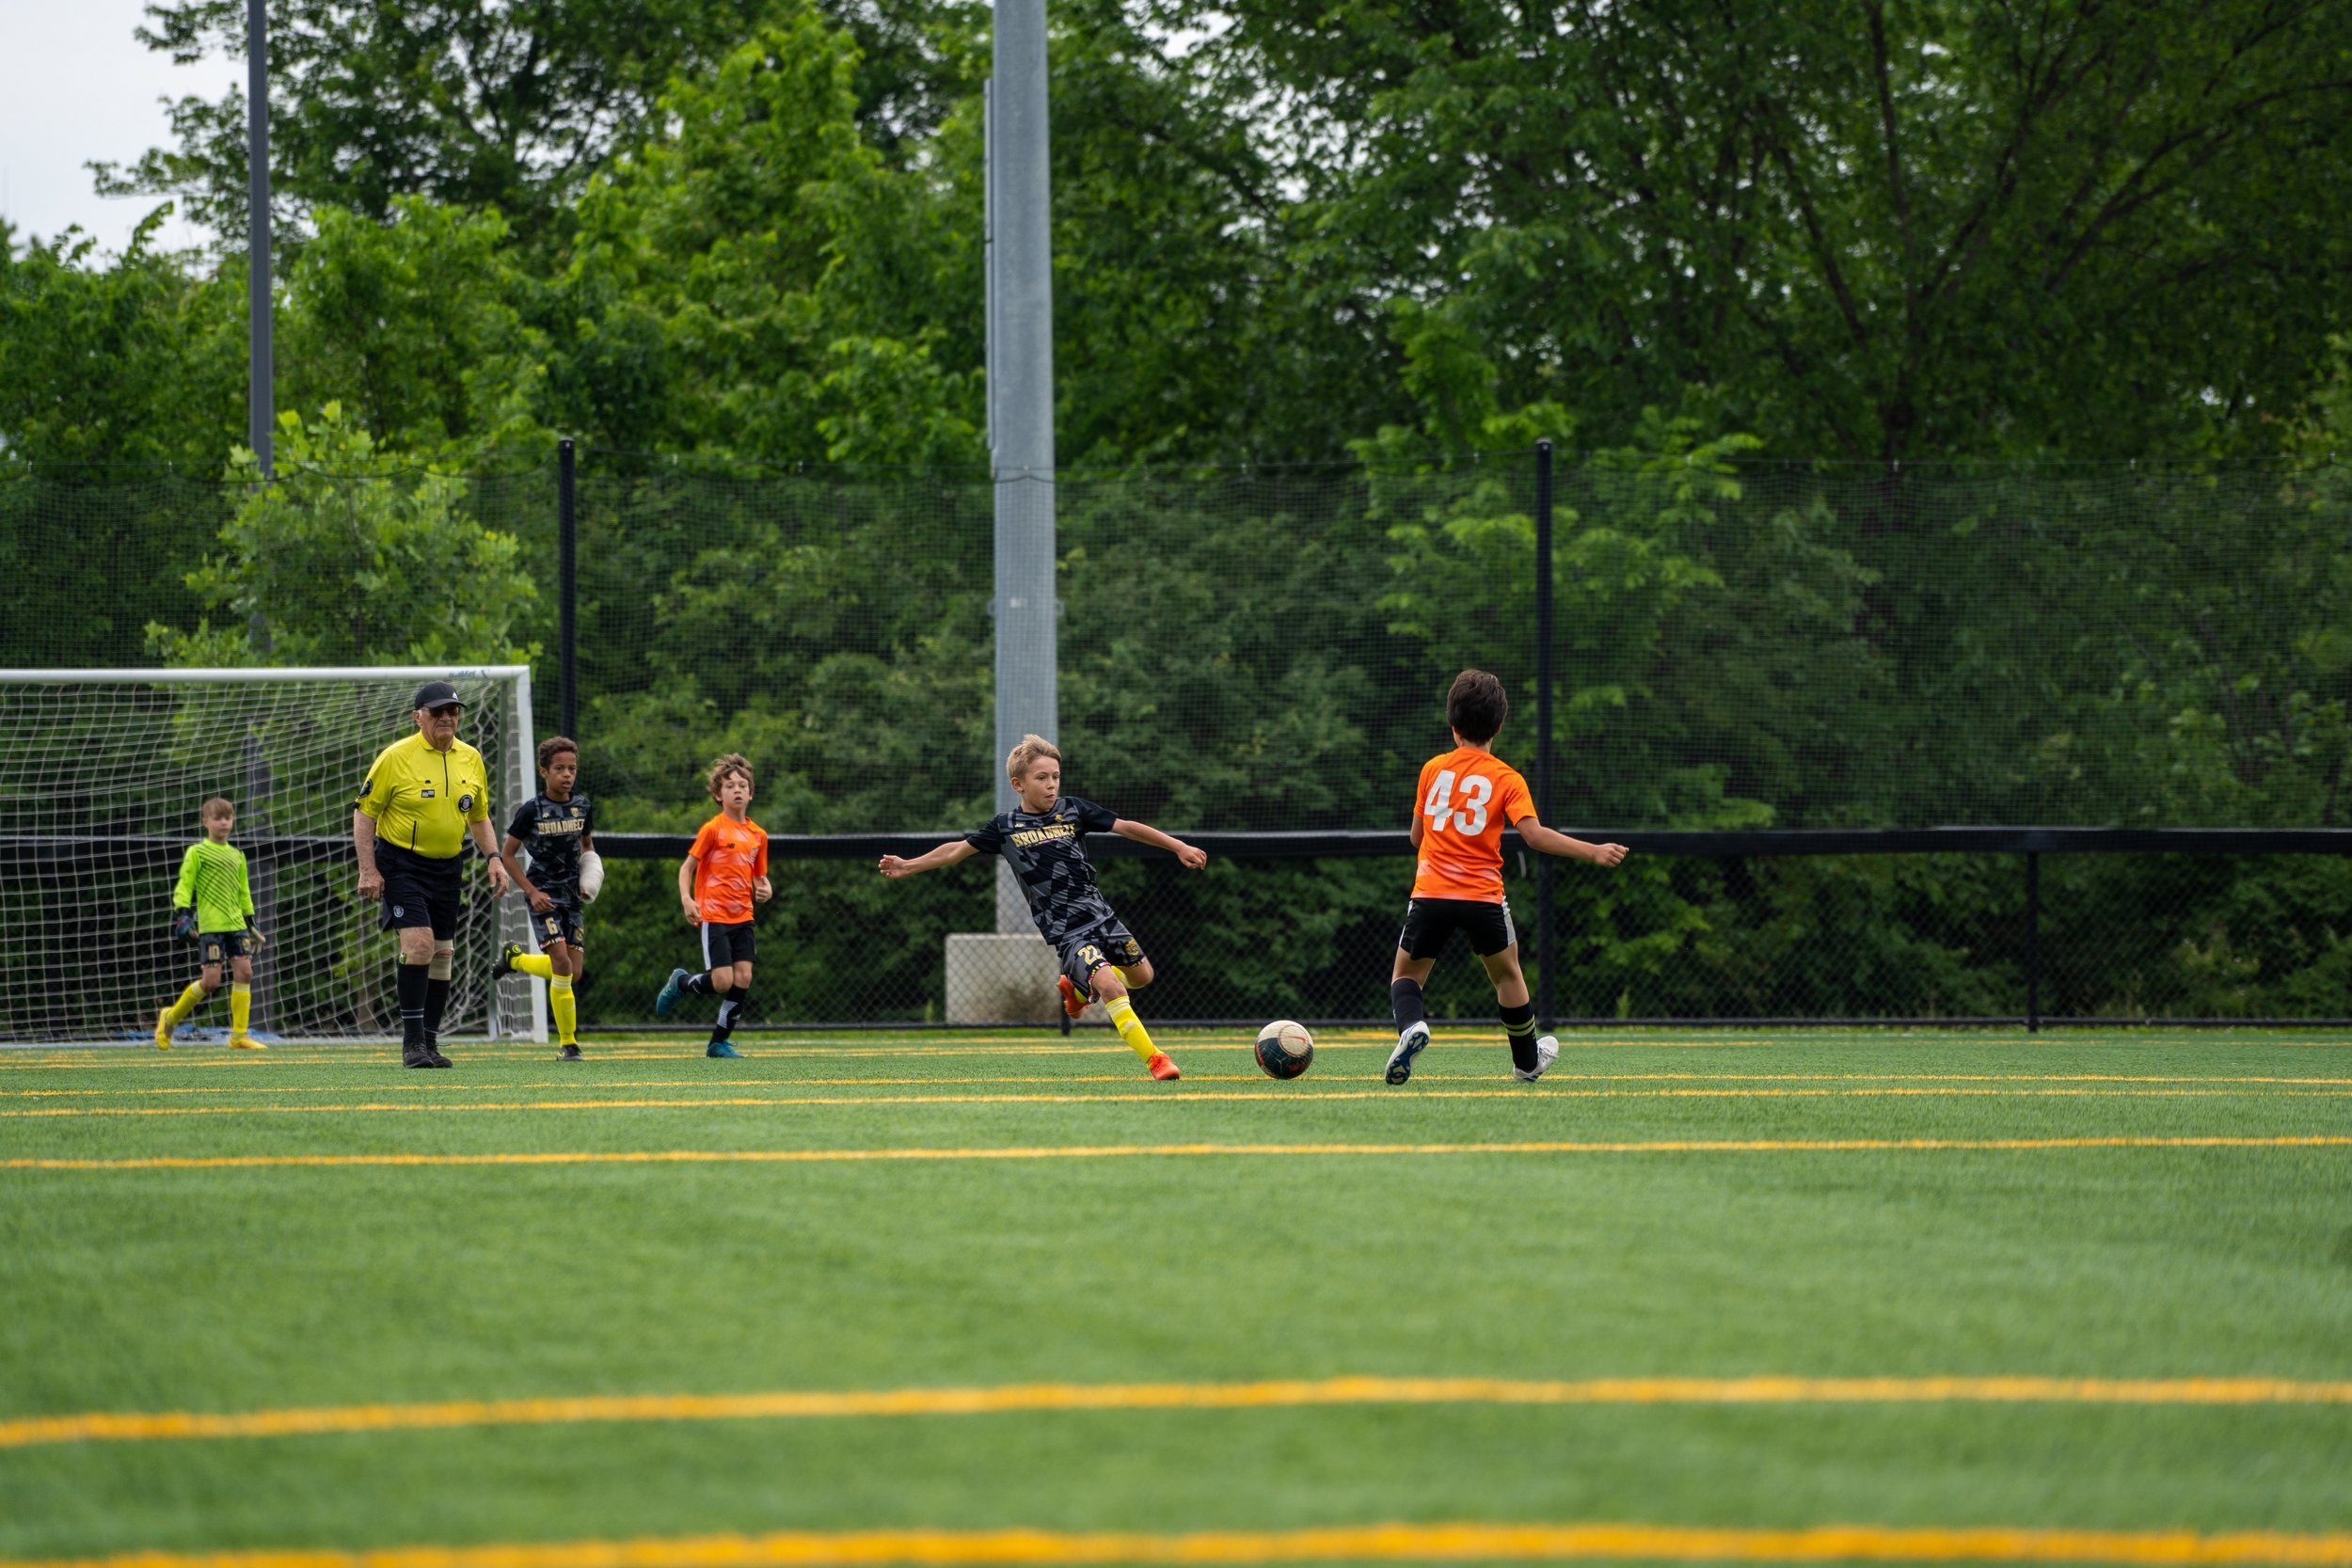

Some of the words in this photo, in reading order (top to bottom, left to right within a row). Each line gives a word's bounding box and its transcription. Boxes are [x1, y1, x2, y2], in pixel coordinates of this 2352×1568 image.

[1424, 769, 1493, 836] 43
[545, 916, 559, 935] 6
[208, 944, 221, 960] 10
[1077, 944, 1104, 966] 22
